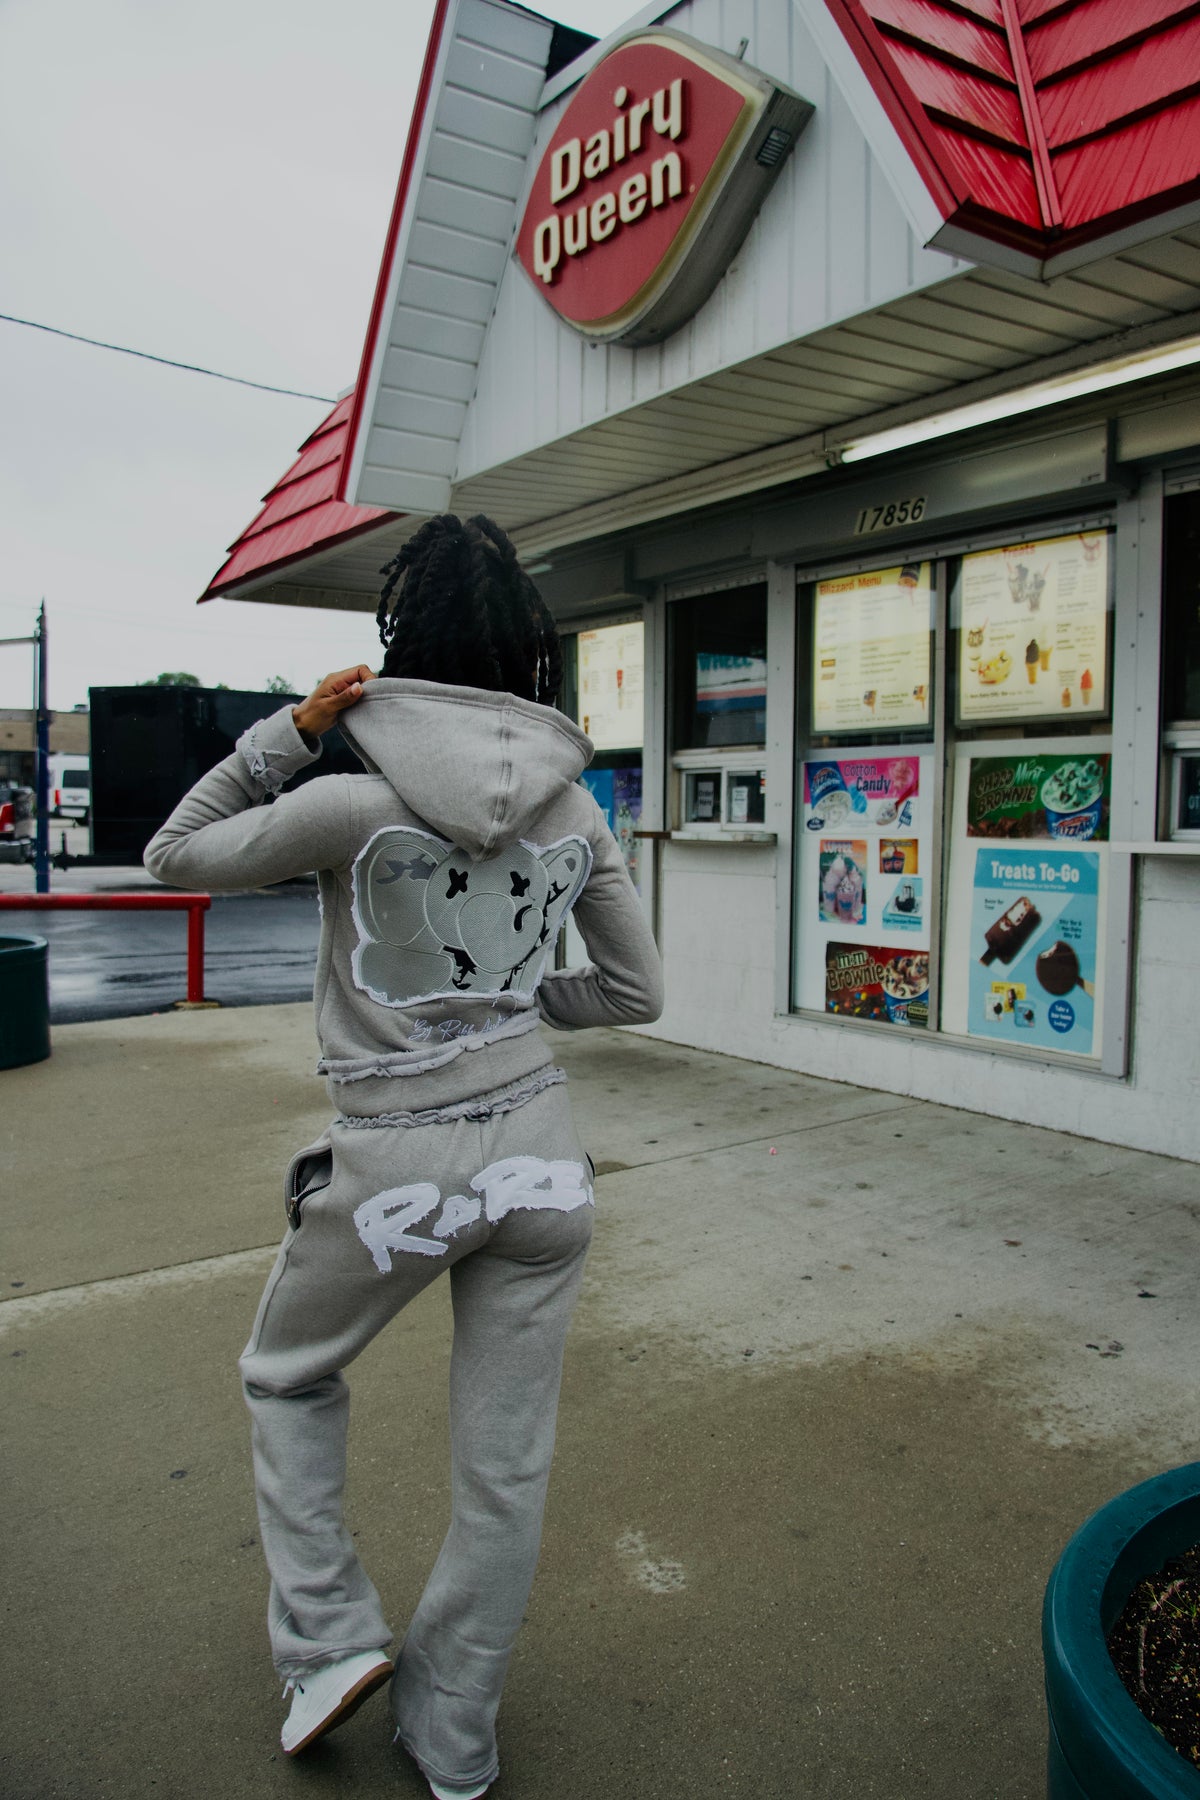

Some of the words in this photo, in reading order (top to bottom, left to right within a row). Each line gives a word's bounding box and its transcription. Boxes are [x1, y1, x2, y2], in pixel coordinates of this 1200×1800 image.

[551, 78, 684, 206] Dairy
[533, 150, 683, 284] Queen
[858, 497, 925, 533] 17856
[858, 574, 882, 589] Menu
[843, 764, 877, 778] Cotton
[856, 775, 891, 795] Candy
[1014, 762, 1046, 785] Mint
[976, 785, 1038, 820] BROWNIE
[991, 861, 1036, 881] Treats
[1039, 863, 1080, 884] To-Go
[827, 958, 885, 991] Brownie
